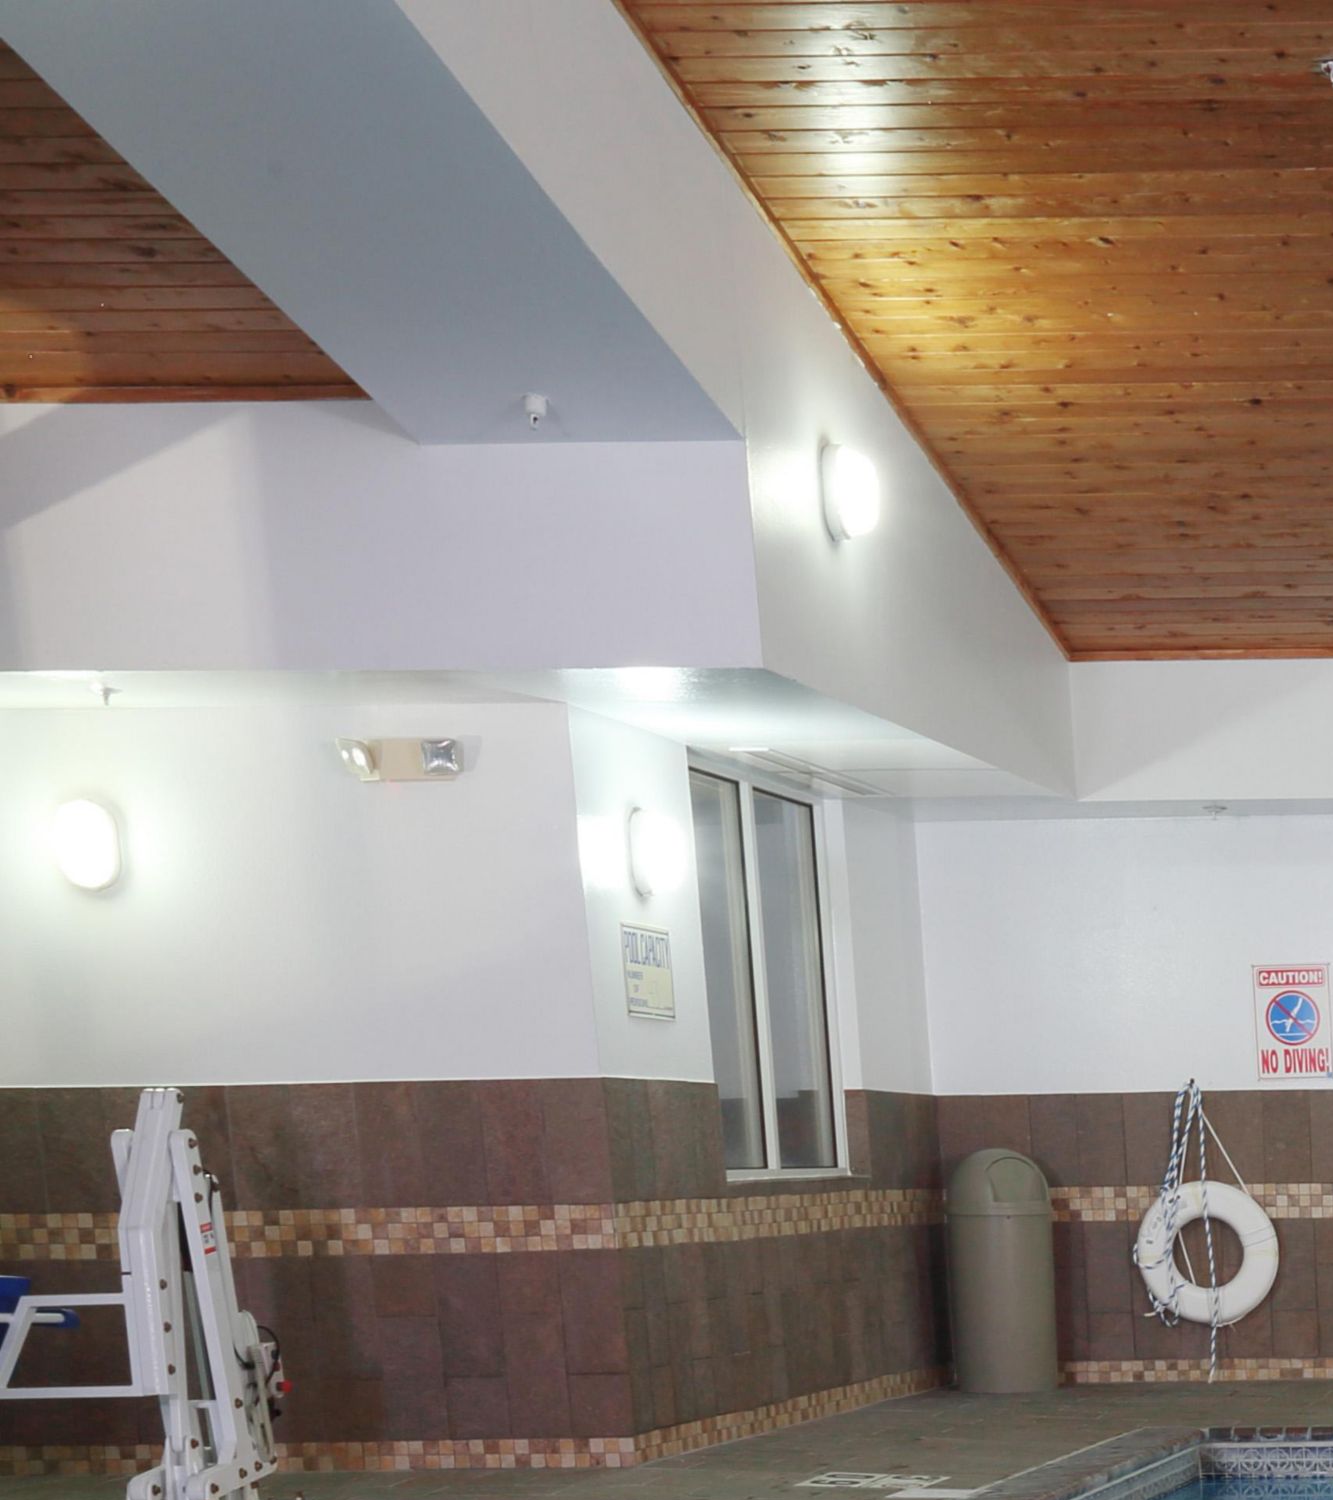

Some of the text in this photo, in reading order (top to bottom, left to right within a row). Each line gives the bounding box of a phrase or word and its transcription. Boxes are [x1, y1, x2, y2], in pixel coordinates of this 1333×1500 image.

[1260, 971, 1322, 984] CAUTION!
[1260, 1048, 1330, 1074] NO DIVING!
